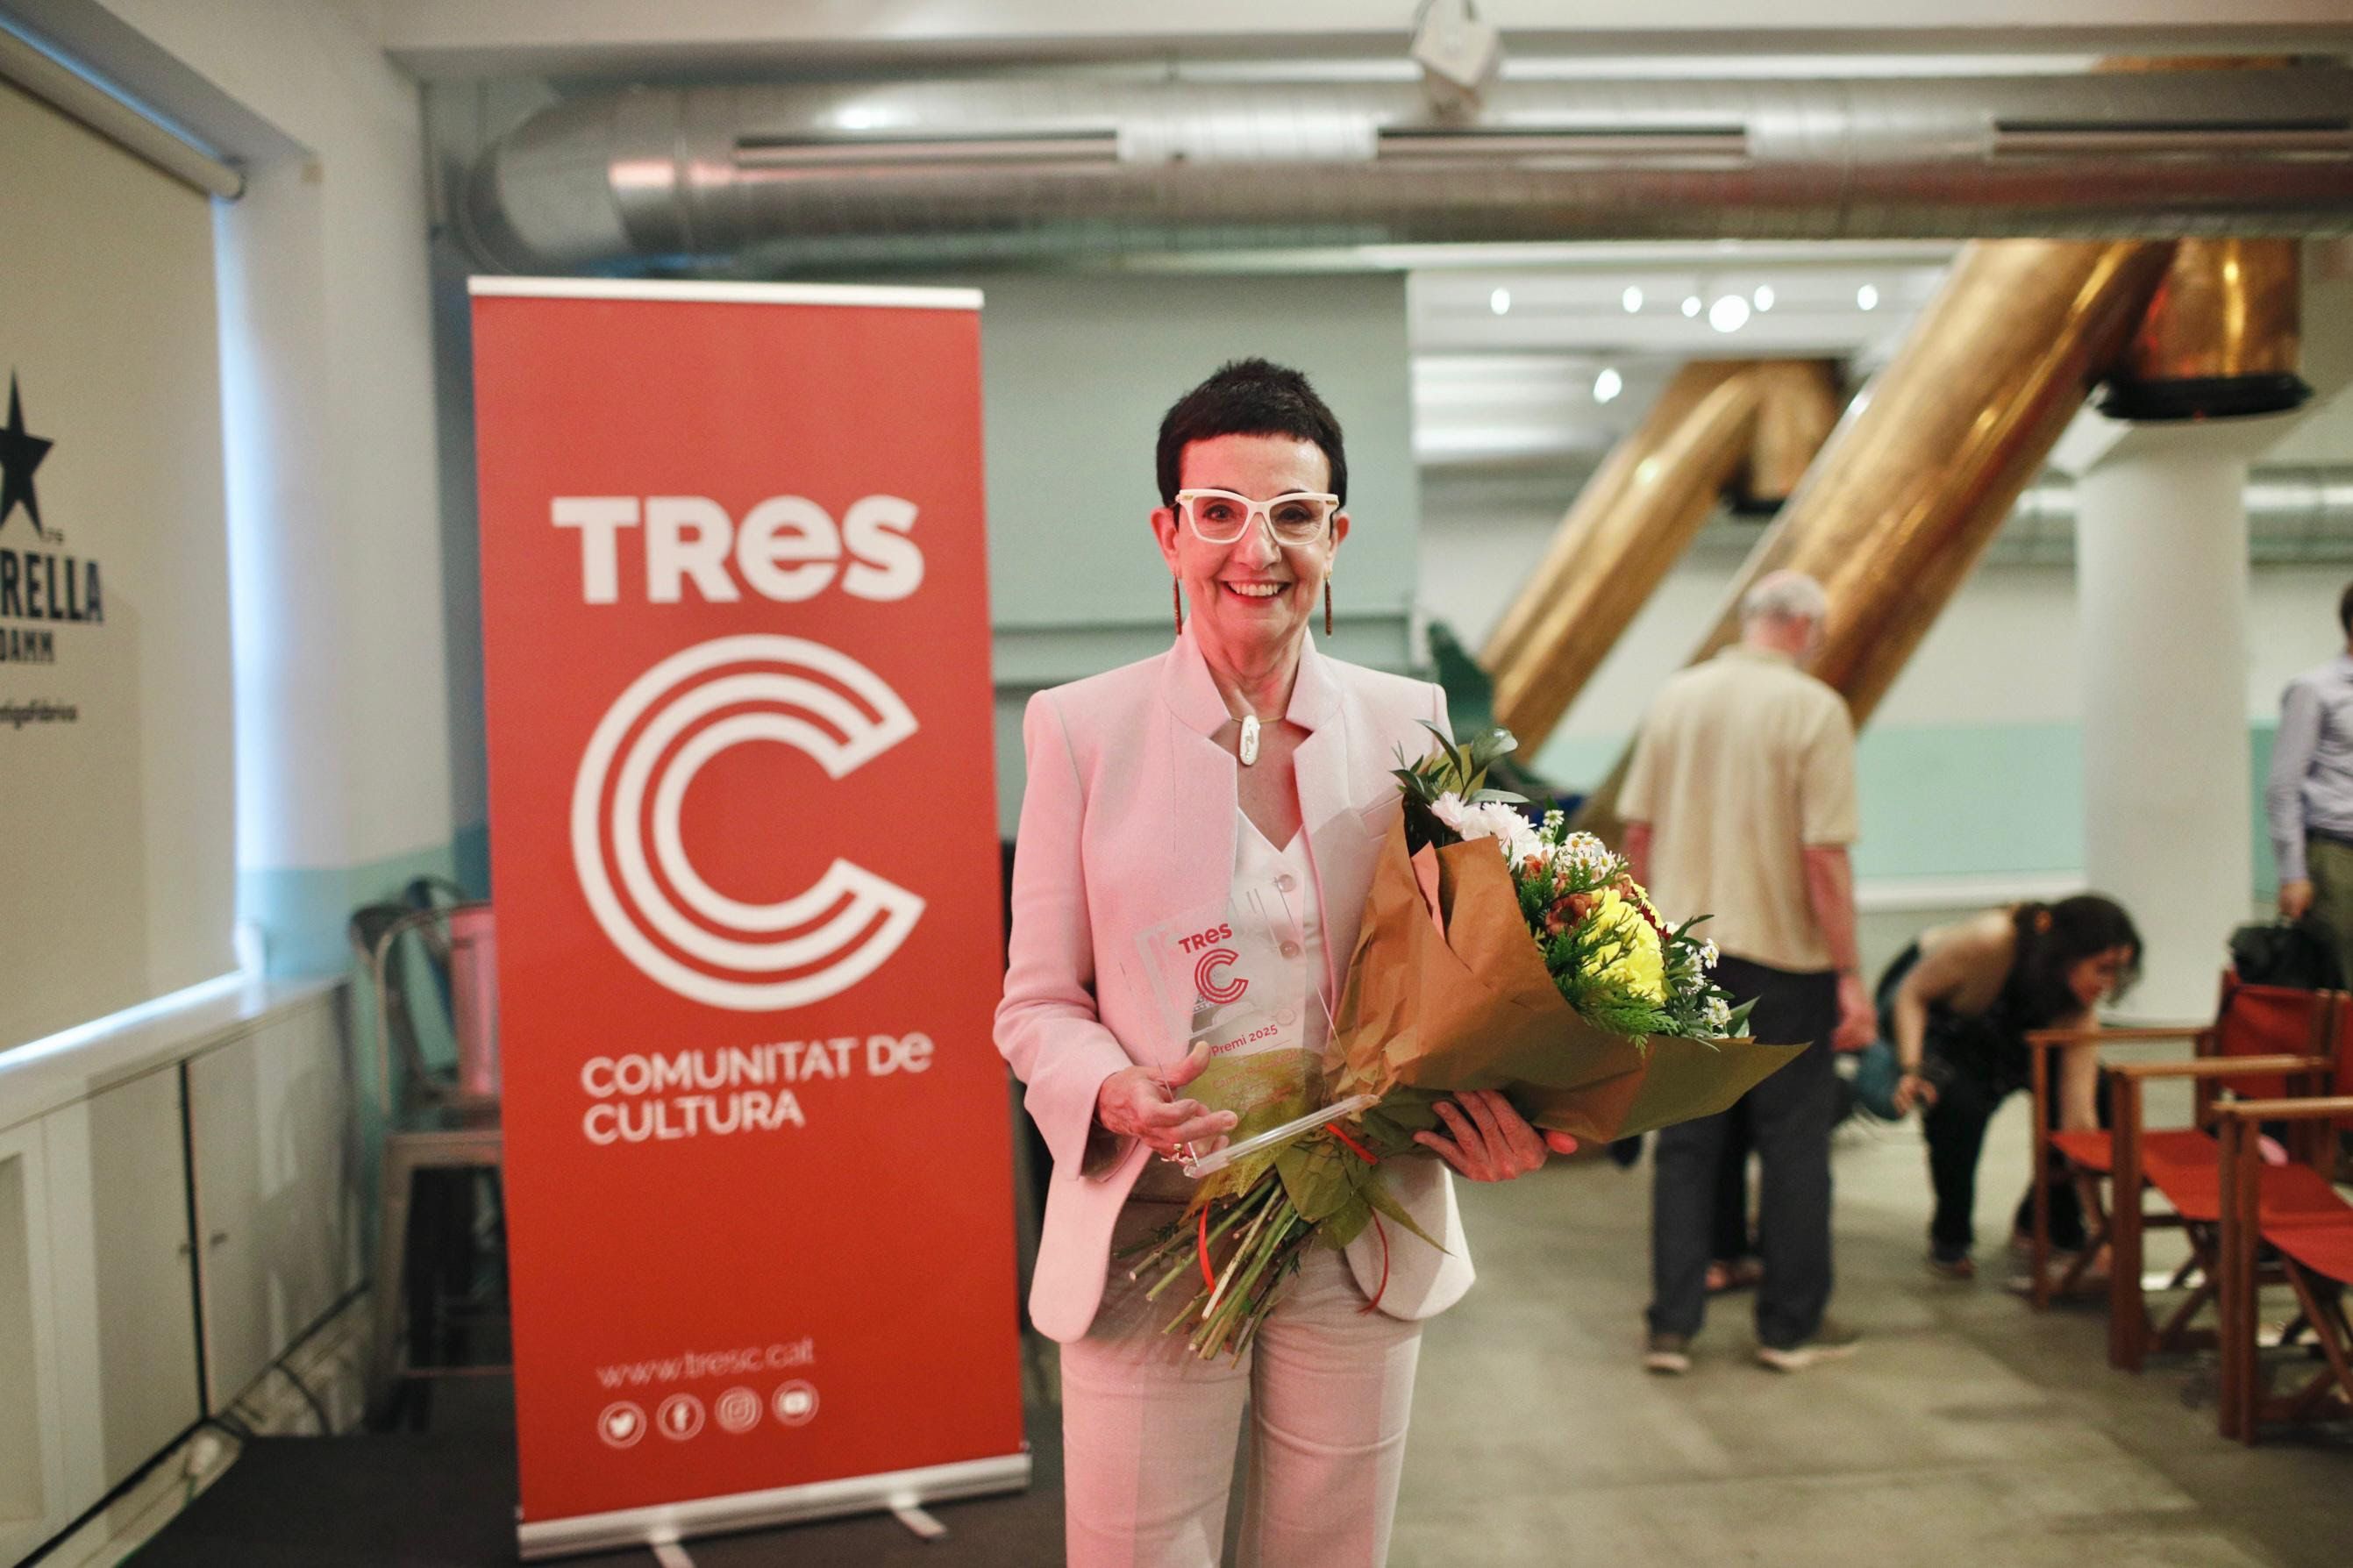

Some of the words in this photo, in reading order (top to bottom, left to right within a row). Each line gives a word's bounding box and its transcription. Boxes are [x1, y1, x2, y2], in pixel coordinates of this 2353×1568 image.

[552, 495, 924, 604] TRes
[0, 547, 103, 624] RELLA
[571, 634, 925, 1010] C
[581, 1037, 858, 1100] COMUNITAT
[1211, 1034, 1247, 1056] Premi
[1249, 1024, 1278, 1042] 2025
[583, 1089, 804, 1144] CULTURA
[596, 1337, 815, 1389] www.tresc.cat
